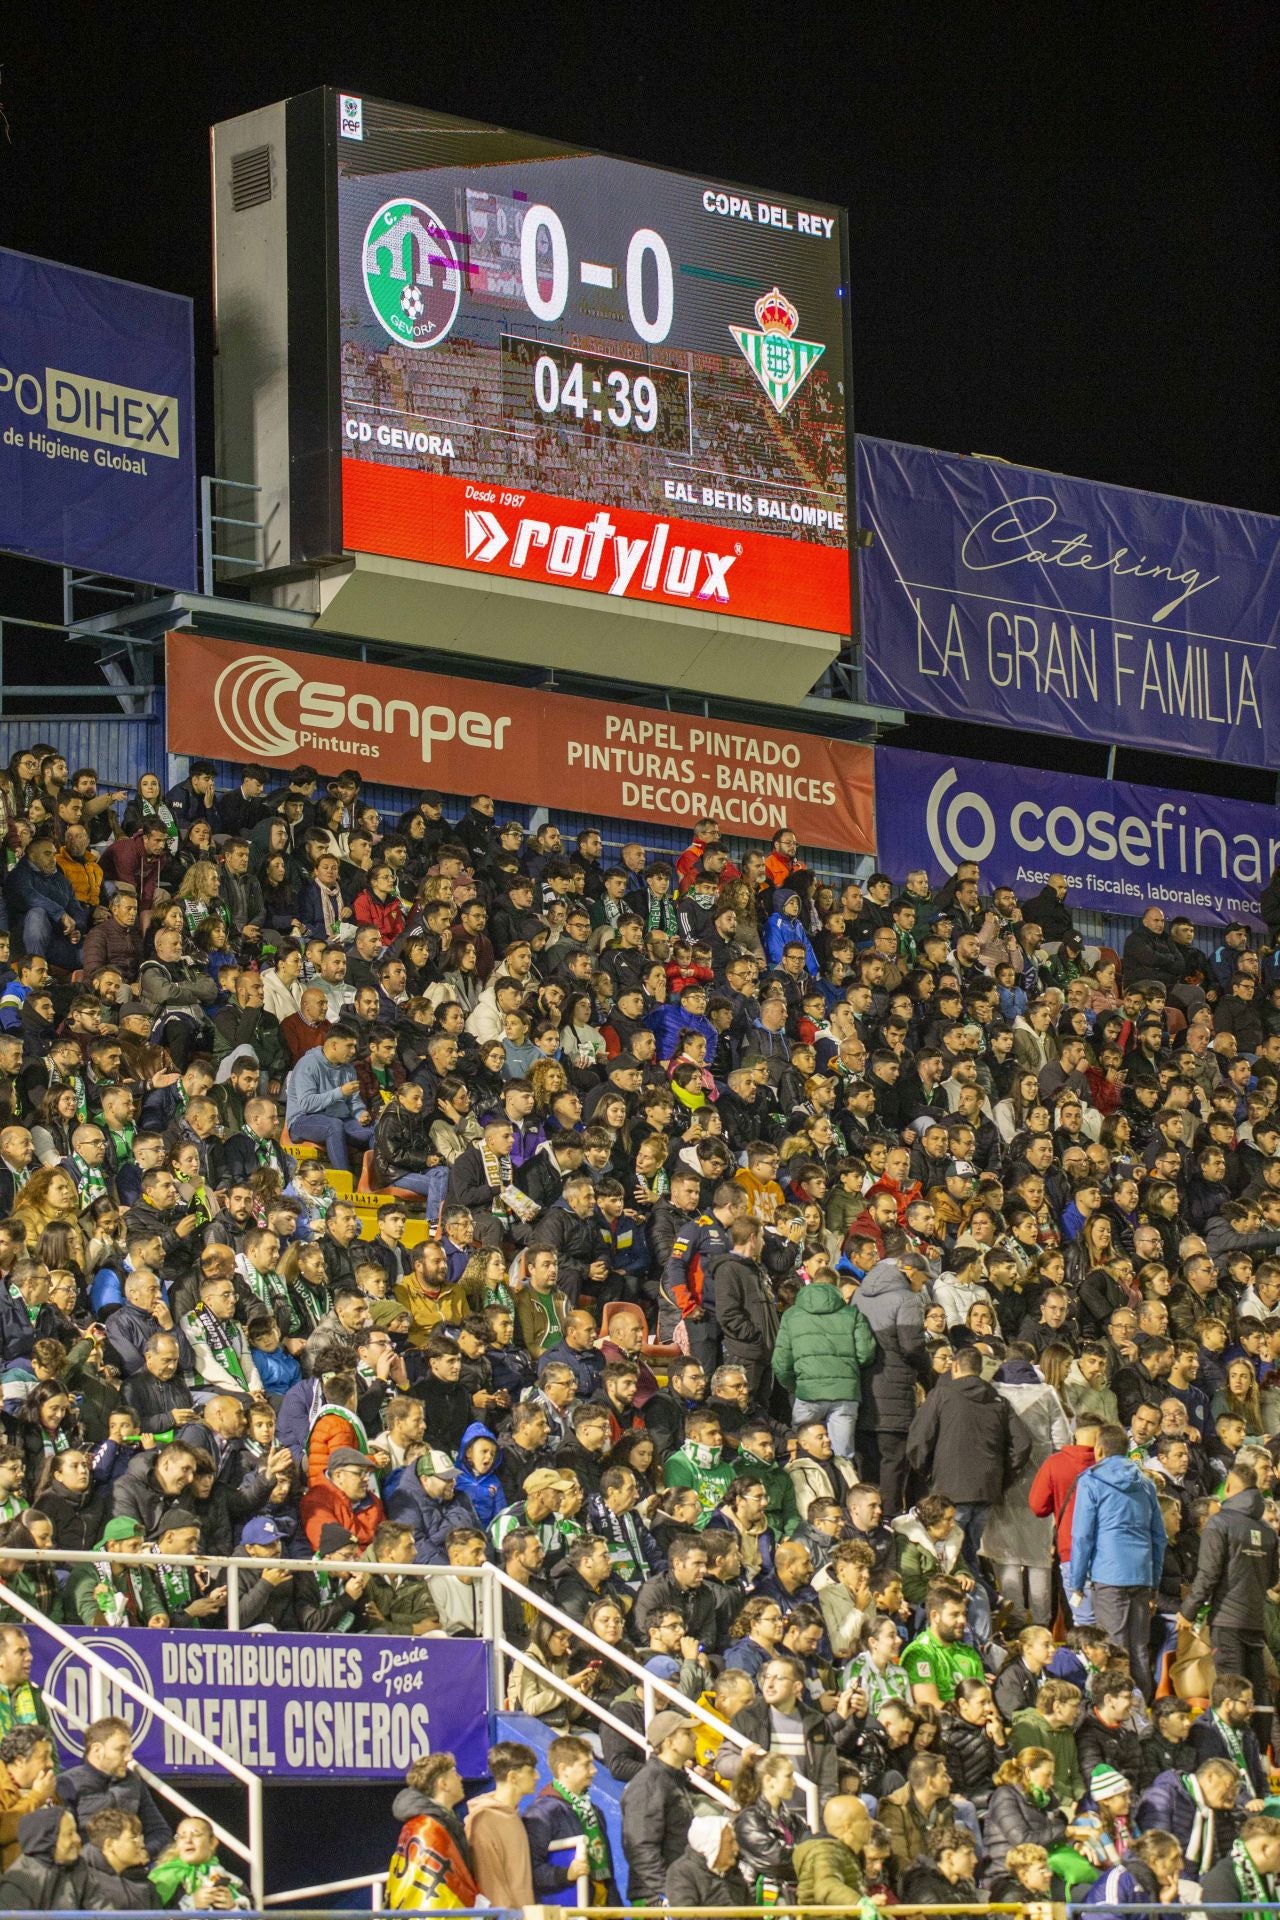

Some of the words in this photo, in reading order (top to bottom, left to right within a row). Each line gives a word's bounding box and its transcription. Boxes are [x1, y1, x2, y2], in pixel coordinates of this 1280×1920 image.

[703, 190, 753, 221] COPA
[758, 202, 793, 230] DEL
[797, 211, 835, 239] REY
[390, 314, 436, 337] GEVORA
[55, 380, 170, 447] DIHEX
[534, 355, 659, 433] 04:39
[3, 427, 24, 447] de
[28, 431, 89, 463] Higiene
[93, 448, 148, 476] Global
[345, 419, 372, 442] CD
[376, 425, 456, 459] GEVORA
[465, 485, 496, 505] Desde
[499, 492, 526, 509] 1987
[664, 480, 698, 504] EAL
[702, 487, 753, 515] BETIS
[757, 497, 845, 531] BALOMPIE
[961, 496, 1220, 623] Catering
[915, 597, 971, 681] LA
[987, 611, 1099, 702] GRAN
[1113, 632, 1263, 729] FAMILIA
[299, 731, 380, 758] Pinturas
[605, 715, 683, 751] PAPEL
[689, 728, 801, 768] PINTADO
[567, 741, 695, 784] PINTURAS
[716, 764, 836, 806] BARNICES
[622, 781, 788, 829] DECORACIÓN
[1016, 865, 1083, 889] Aseses
[1086, 873, 1145, 900] fiscales,
[1147, 882, 1212, 908] laborales
[1215, 895, 1224, 912] y
[161, 1641, 363, 1690] DISTRIBUCIONES
[371, 1645, 429, 1684] Desde
[384, 1673, 424, 1698] 1984
[163, 1697, 276, 1768] RAFAEL
[283, 1699, 432, 1769] CISNEROS
